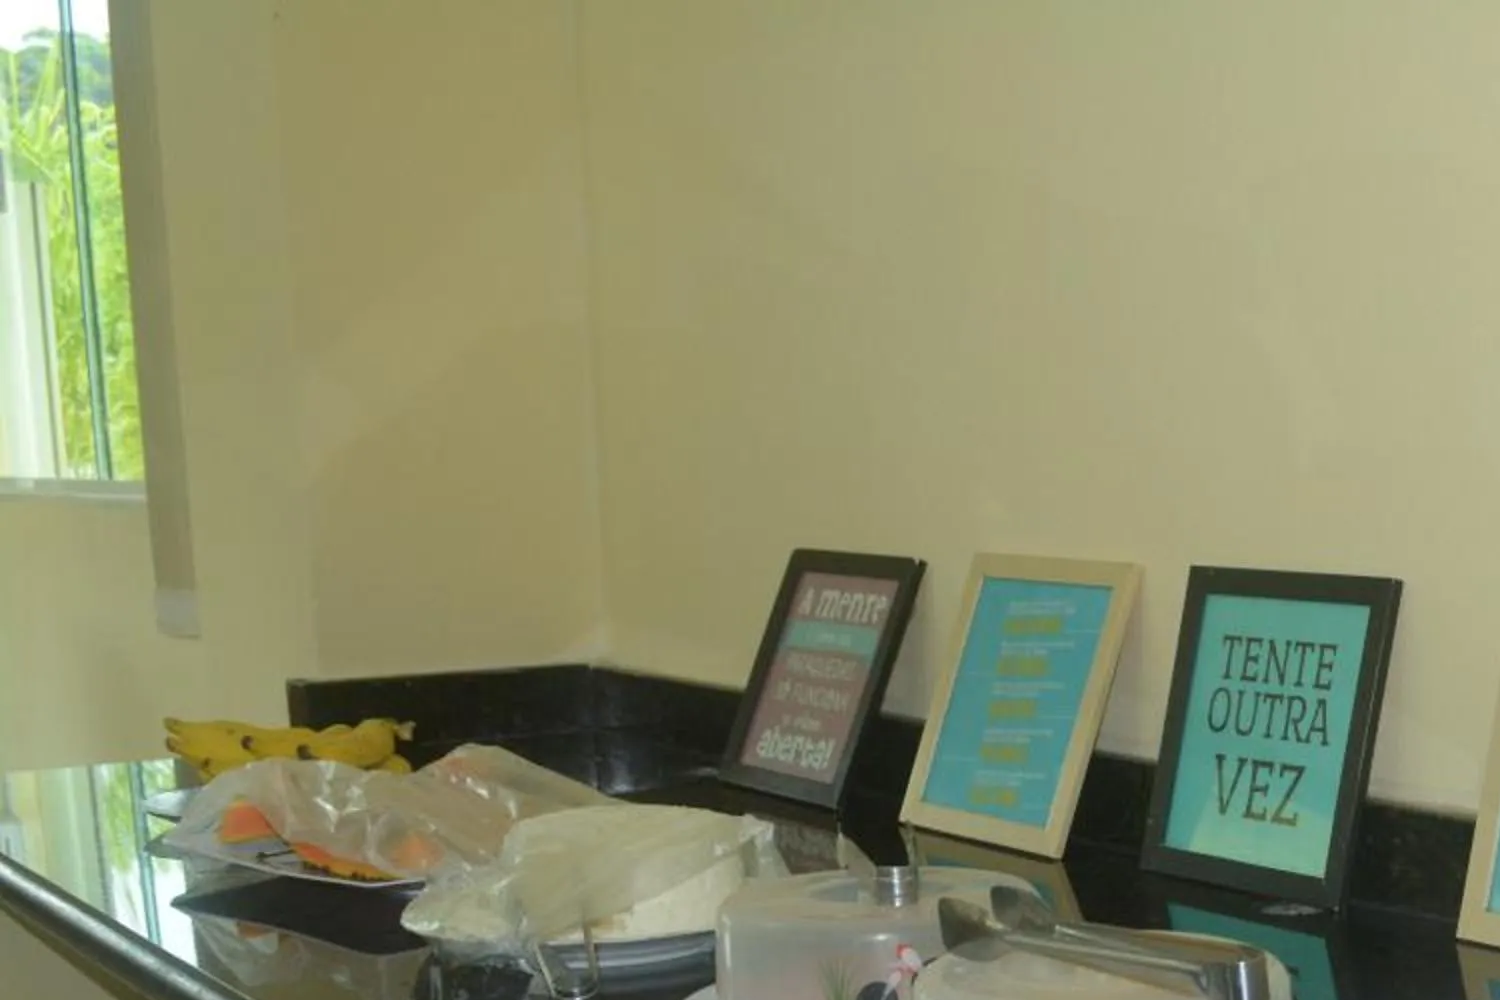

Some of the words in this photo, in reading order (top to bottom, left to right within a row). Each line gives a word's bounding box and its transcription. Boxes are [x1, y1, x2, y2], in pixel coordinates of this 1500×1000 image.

[1223, 634, 1338, 691] TENTE
[1207, 687, 1331, 747] OUTRA
[1215, 753, 1306, 827] VEZ
